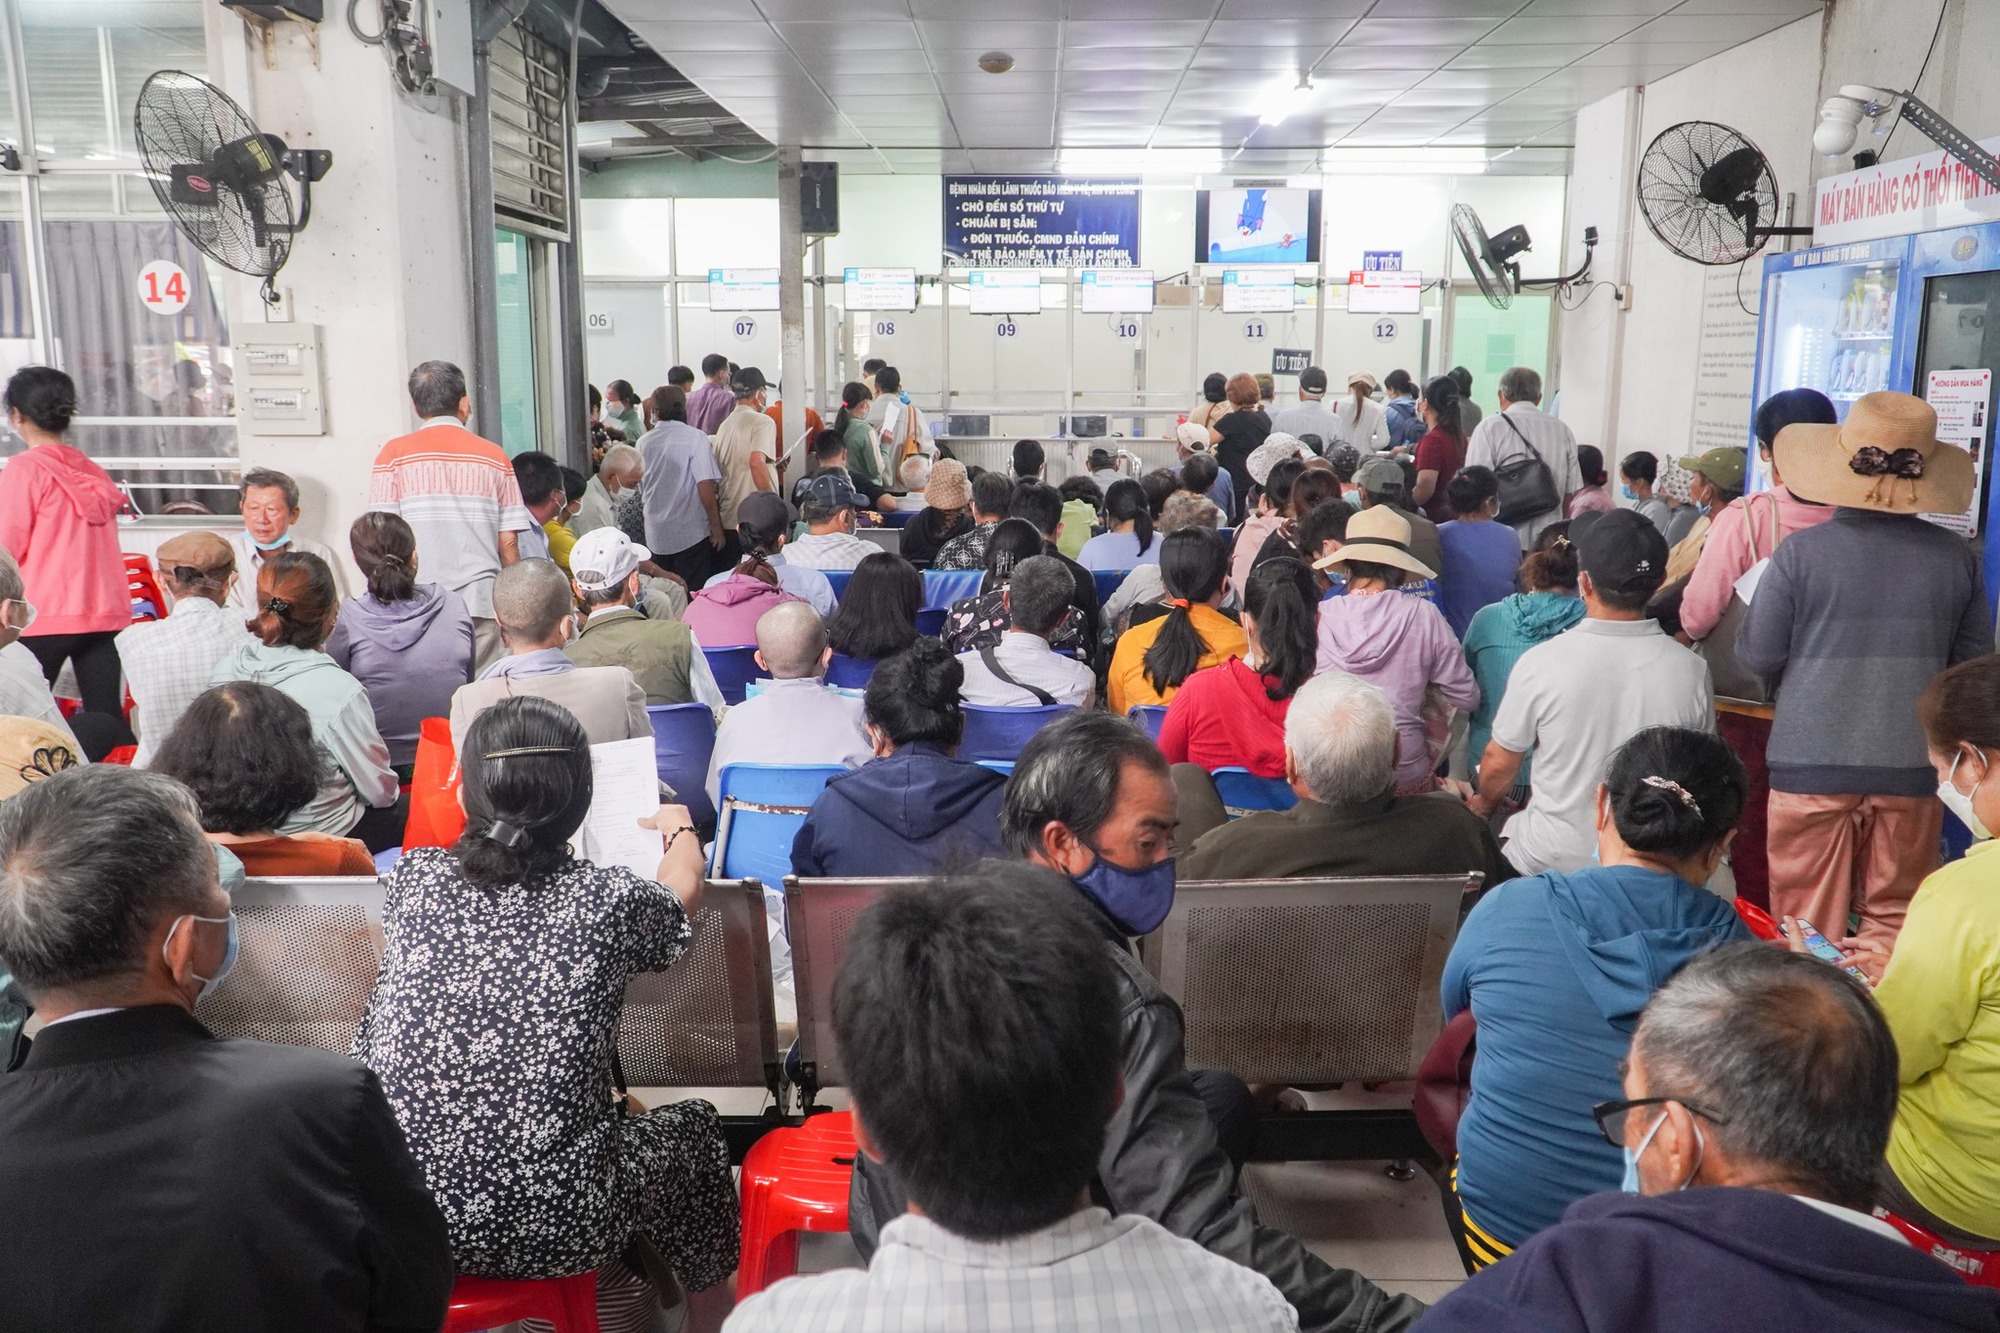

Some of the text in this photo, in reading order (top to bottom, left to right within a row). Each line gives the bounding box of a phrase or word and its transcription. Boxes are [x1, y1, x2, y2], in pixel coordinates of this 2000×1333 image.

[1020, 180, 1041, 195] THUỐC
[1042, 180, 1056, 195] BẢO
[1820, 181, 1843, 226] MÁY
[1843, 176, 1866, 222] BÁN
[1866, 171, 1899, 218] HÀNG
[1901, 161, 1921, 212] CÓ
[961, 199, 984, 212] CHỜ
[985, 198, 1007, 212] ĐẾN
[1009, 198, 1024, 212] SỐ
[1026, 199, 1049, 213] THỨ
[1049, 200, 1065, 215] TỰ
[961, 213, 997, 228] CHUẨN
[1000, 217, 1011, 231] BỊ
[970, 232, 992, 244] ĐƠN
[994, 230, 1033, 245] THUỐC,
[1034, 233, 1063, 245] CMND
[1065, 230, 1086, 245] BẢN
[1088, 231, 1119, 245] CHÍNH
[971, 246, 992, 259] THẺ
[994, 246, 1016, 259] BẢO
[1046, 249, 1054, 259] Y
[1056, 246, 1070, 259] TẾ
[1072, 246, 1094, 259] BẢN
[1379, 253, 1400, 271] TIÊN
[144, 271, 187, 303] 14
[589, 313, 607, 327] 06
[736, 322, 754, 335] 07
[876, 322, 895, 335] 08
[997, 323, 1015, 337] 09
[1119, 324, 1136, 337] 10
[1247, 324, 1264, 337] 11
[1376, 324, 1394, 337] 12
[1275, 353, 1308, 371] ƯU TIÊN
